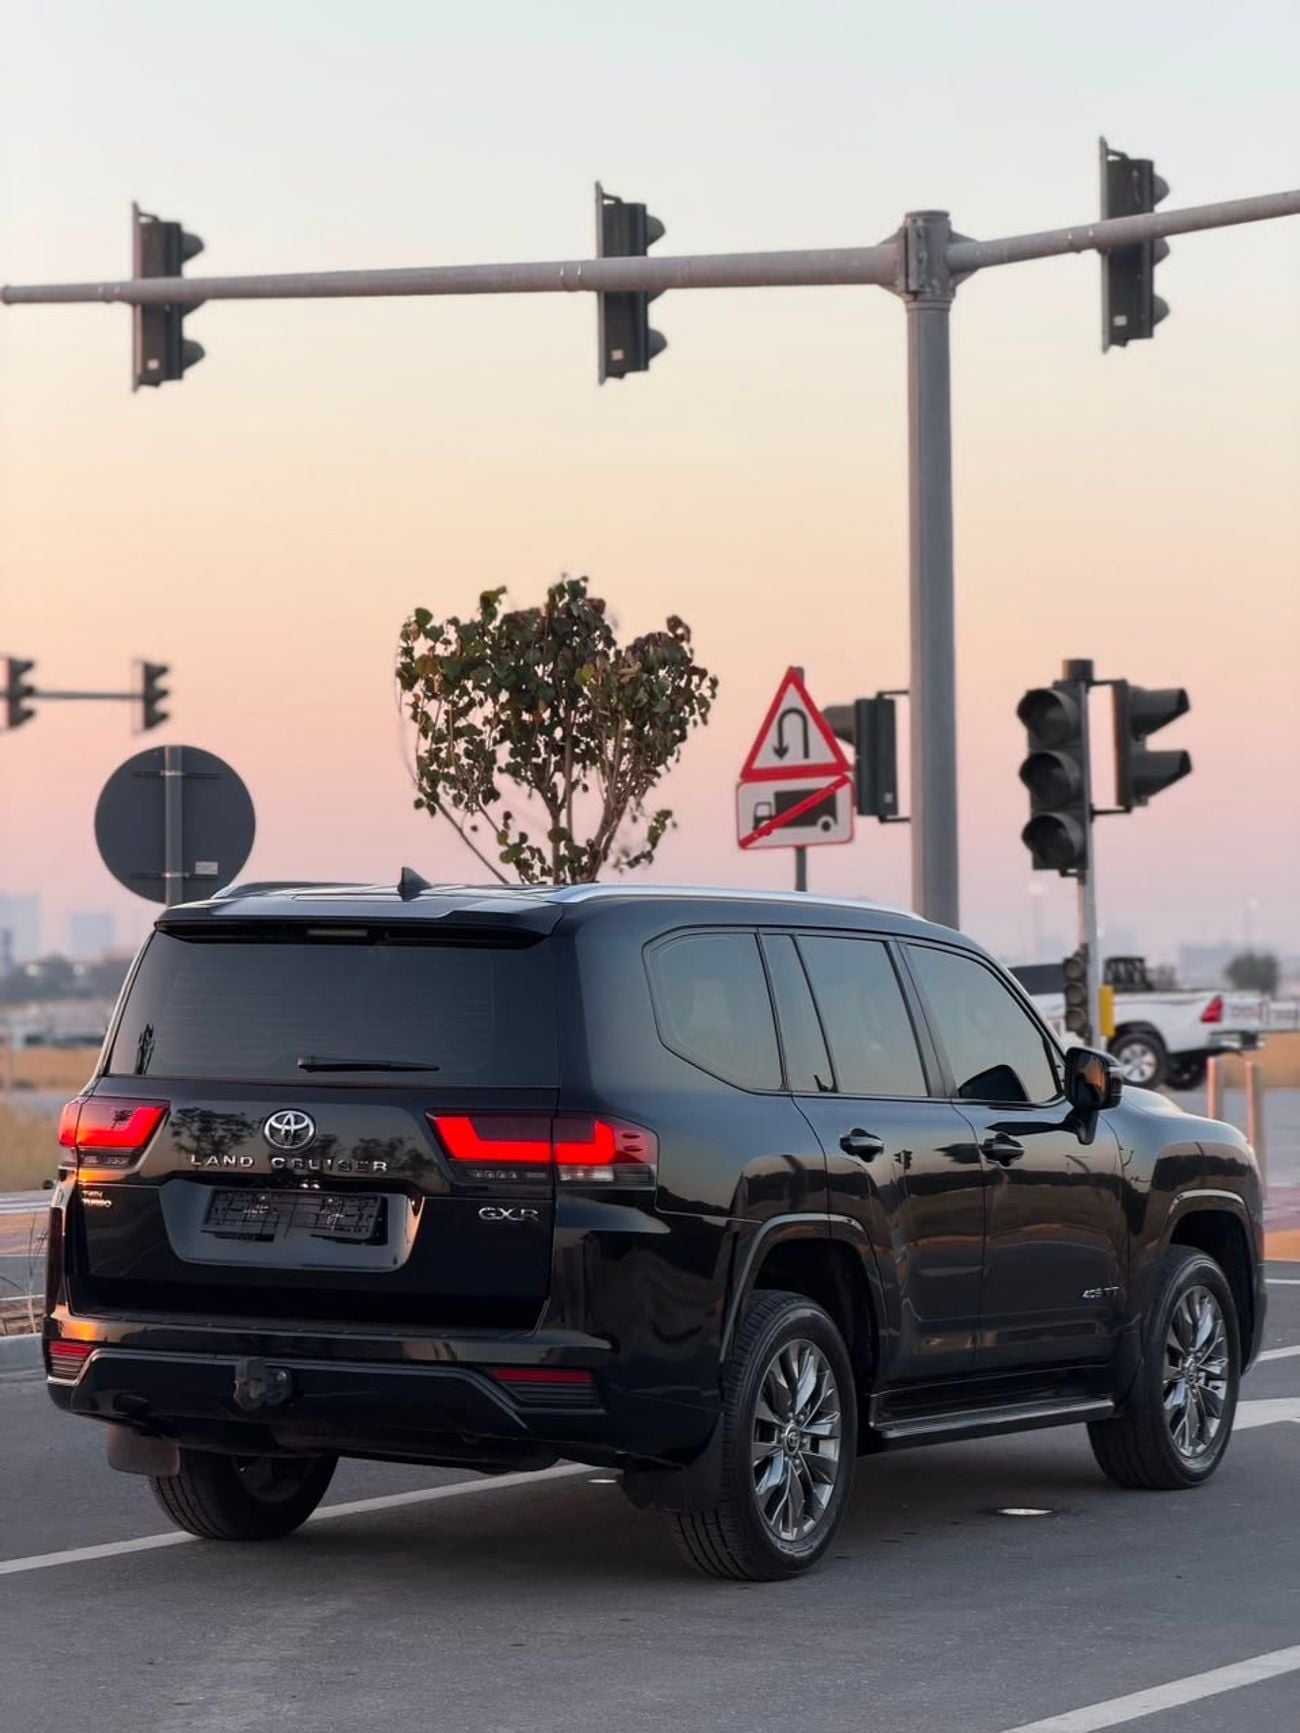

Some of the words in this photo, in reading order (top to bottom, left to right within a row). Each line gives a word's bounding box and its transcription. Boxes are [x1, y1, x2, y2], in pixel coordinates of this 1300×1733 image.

[190, 1154, 255, 1168] LAND
[270, 1157, 388, 1173] CRUISER
[478, 1207, 540, 1222] GXR
